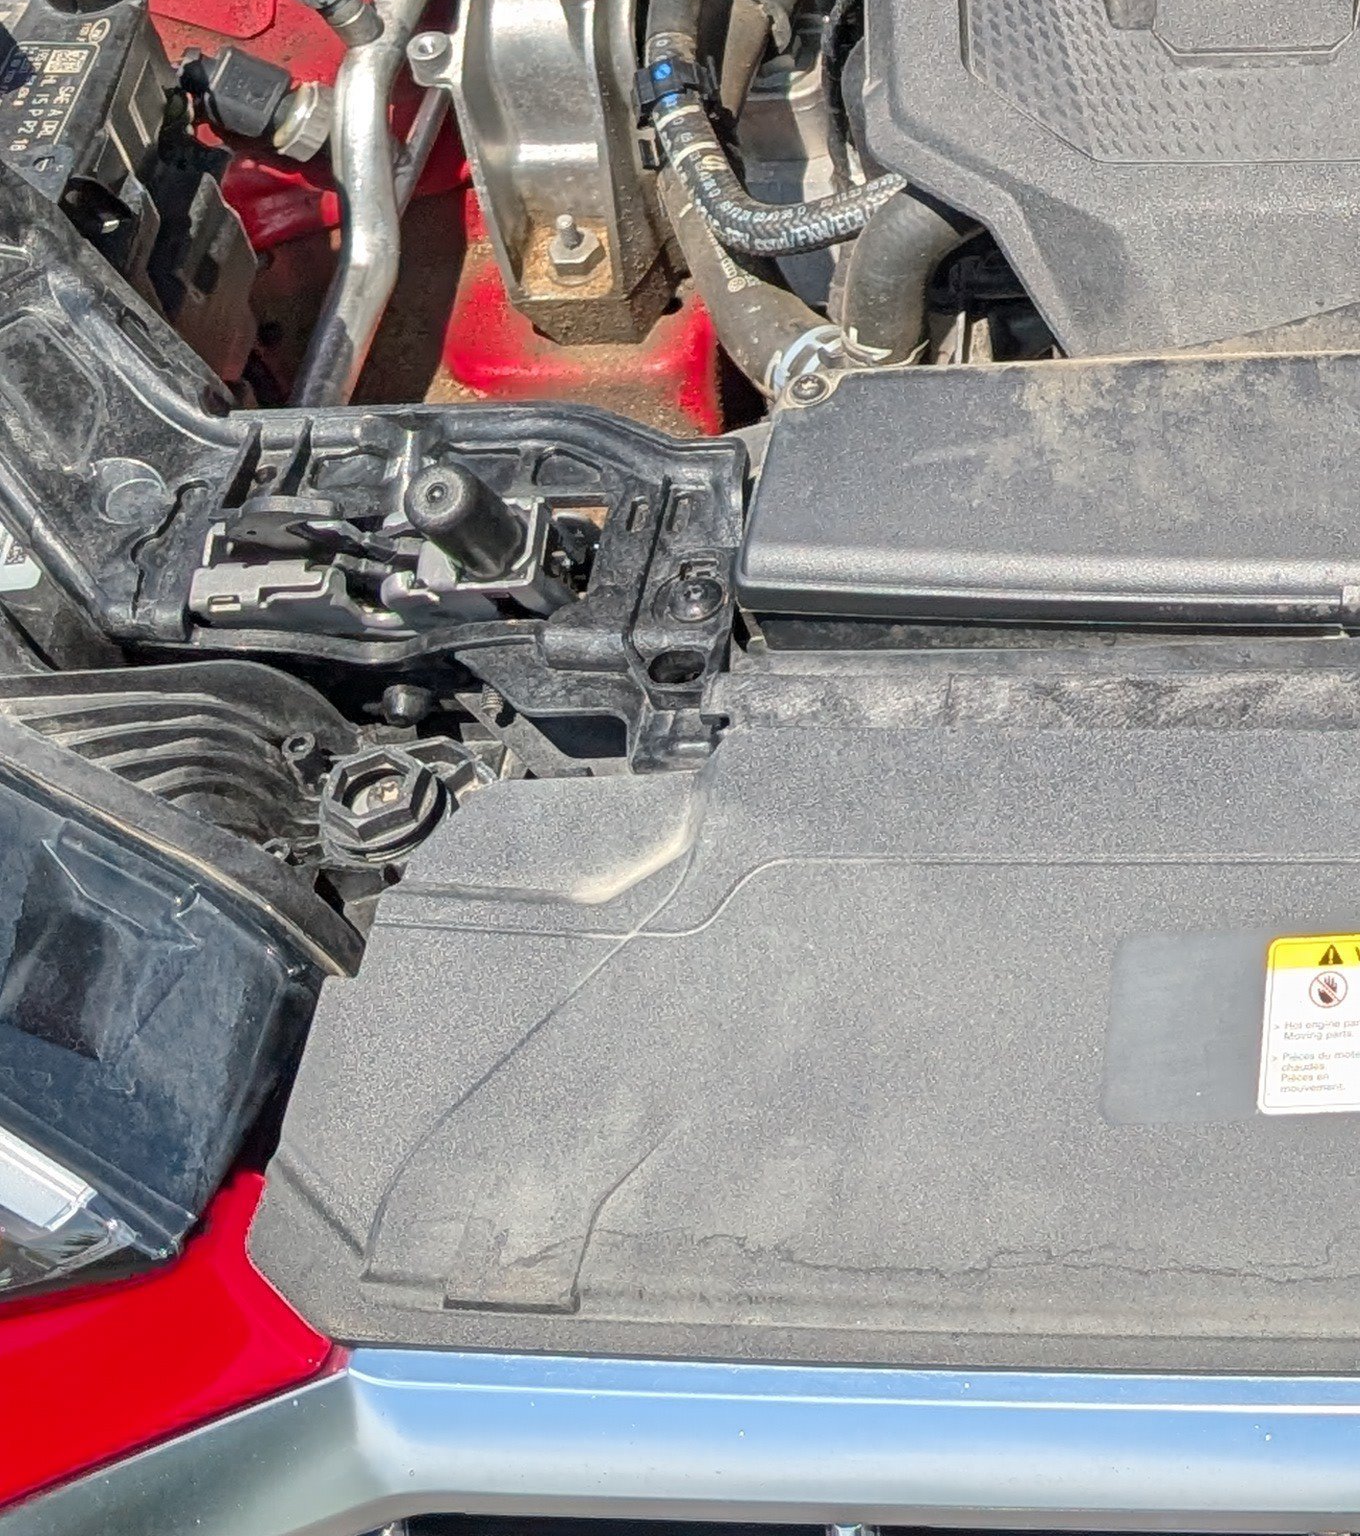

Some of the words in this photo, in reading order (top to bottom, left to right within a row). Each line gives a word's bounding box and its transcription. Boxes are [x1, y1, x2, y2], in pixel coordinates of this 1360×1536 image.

[53, 85, 75, 105] SAE
[28, 109, 44, 117] P
[47, 109, 64, 117] A
[17, 120, 39, 134] P2
[36, 120, 60, 139] DRL
[1284, 1021, 1302, 1029] Hot
[1305, 1020, 1340, 1030] engine
[1284, 1032, 1323, 1041] Moving
